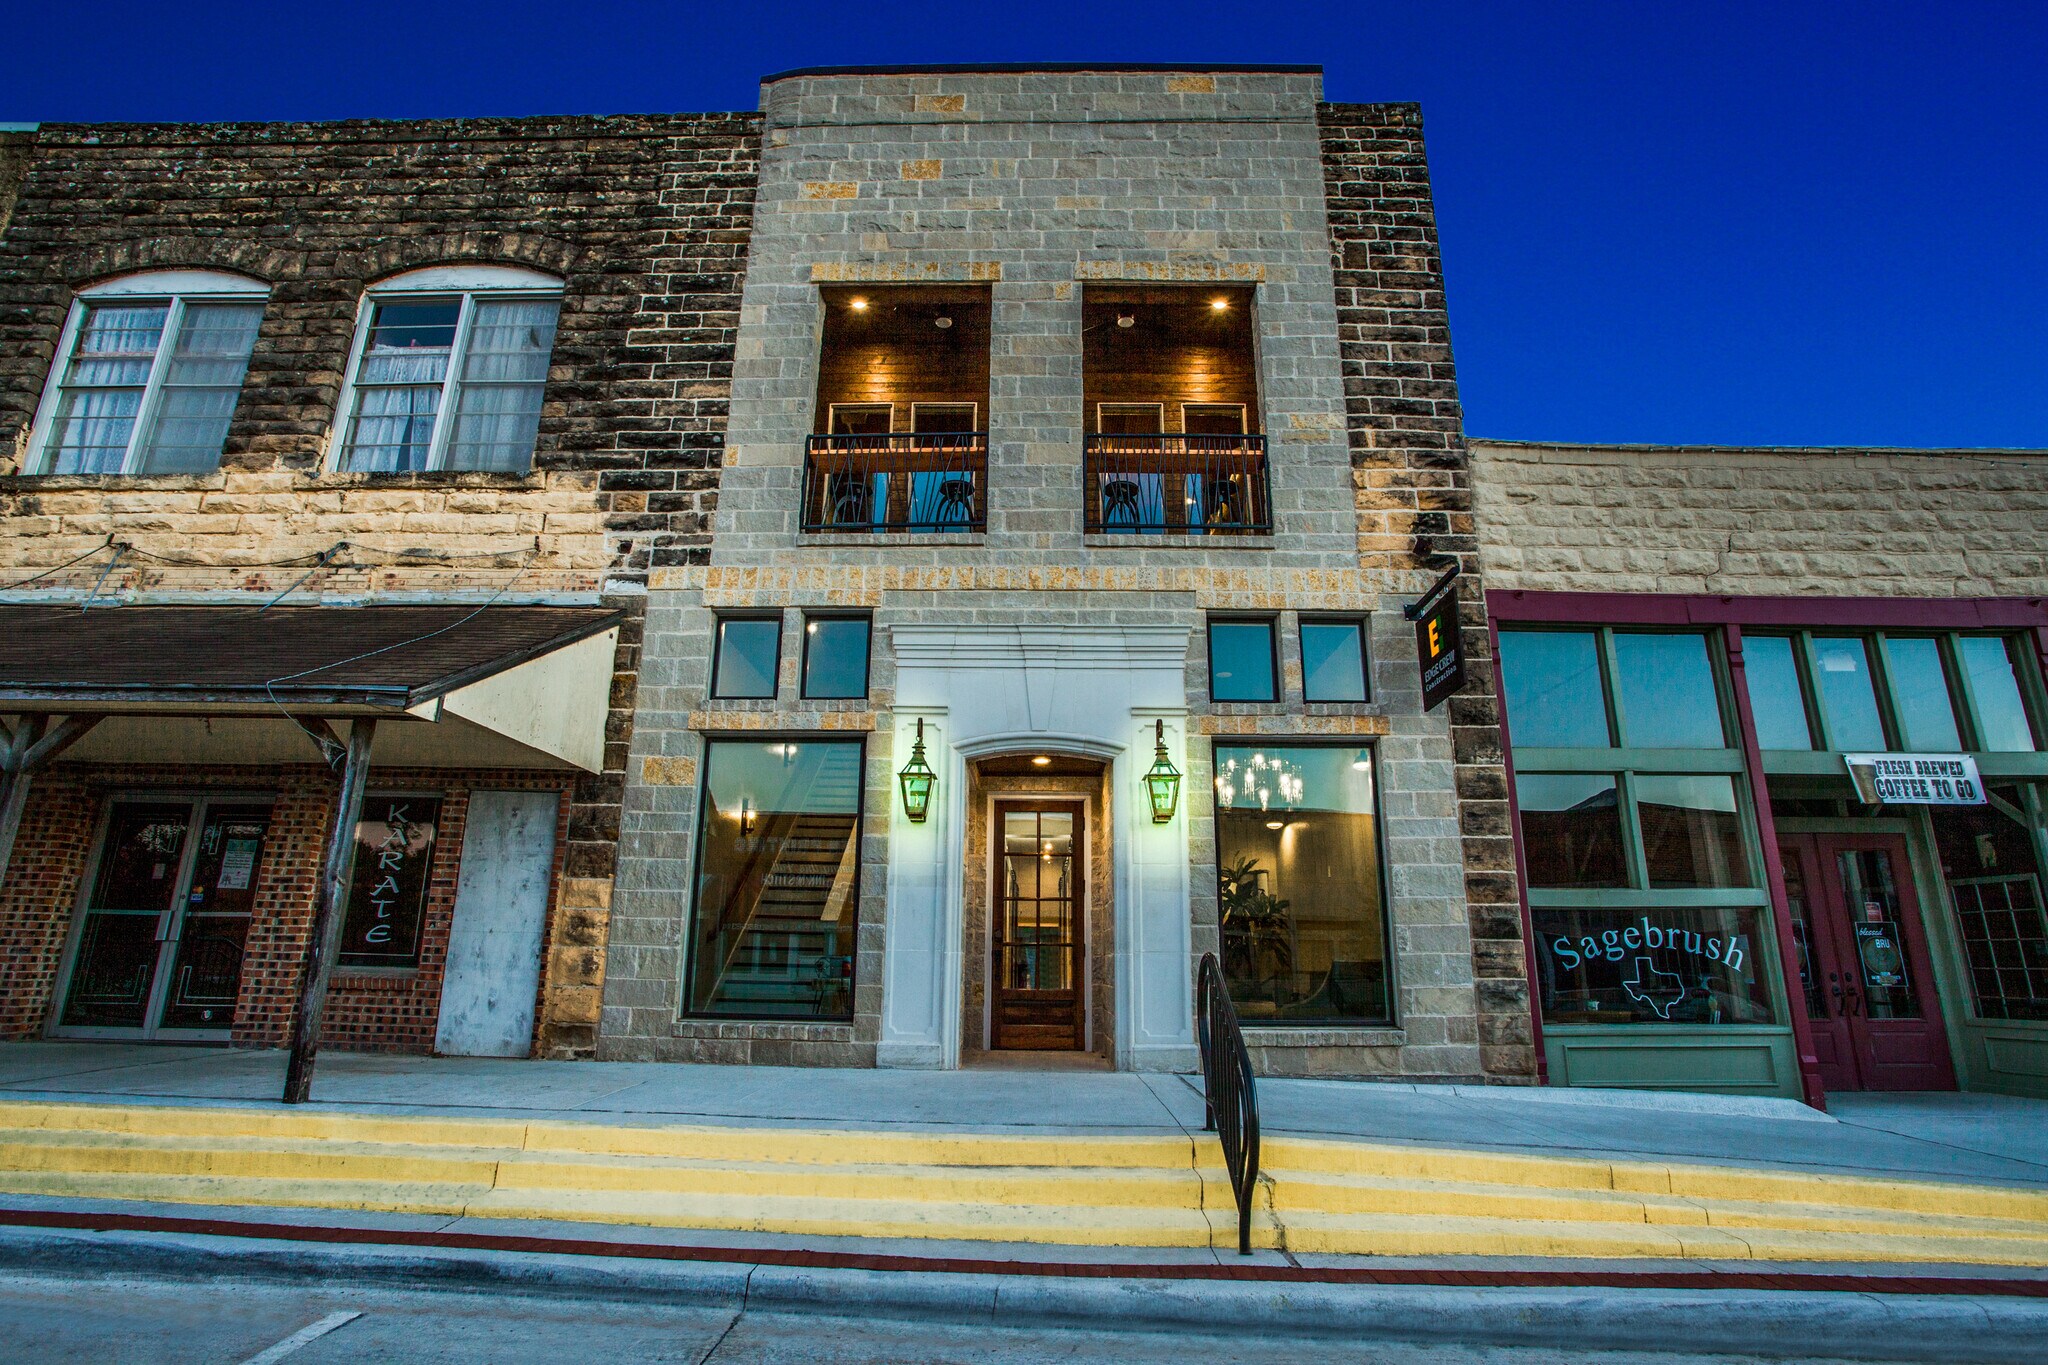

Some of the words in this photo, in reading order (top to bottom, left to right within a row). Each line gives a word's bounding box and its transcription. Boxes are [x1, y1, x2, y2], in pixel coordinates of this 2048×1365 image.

[1428, 615, 1444, 658] E
[1424, 662, 1440, 683] EDGE
[1439, 649, 1455, 671] CREW
[1425, 665, 1457, 692] Construction
[1875, 760, 1914, 776] FRESH
[1915, 760, 1965, 777] BREWED
[1875, 778, 1930, 799] COFFEE
[1932, 779, 1953, 799] TO
[1956, 779, 1976, 799] GO
[365, 803, 410, 943] KARATE
[1553, 916, 1744, 972] Sagebrush
[1859, 927, 1884, 936] blessed
